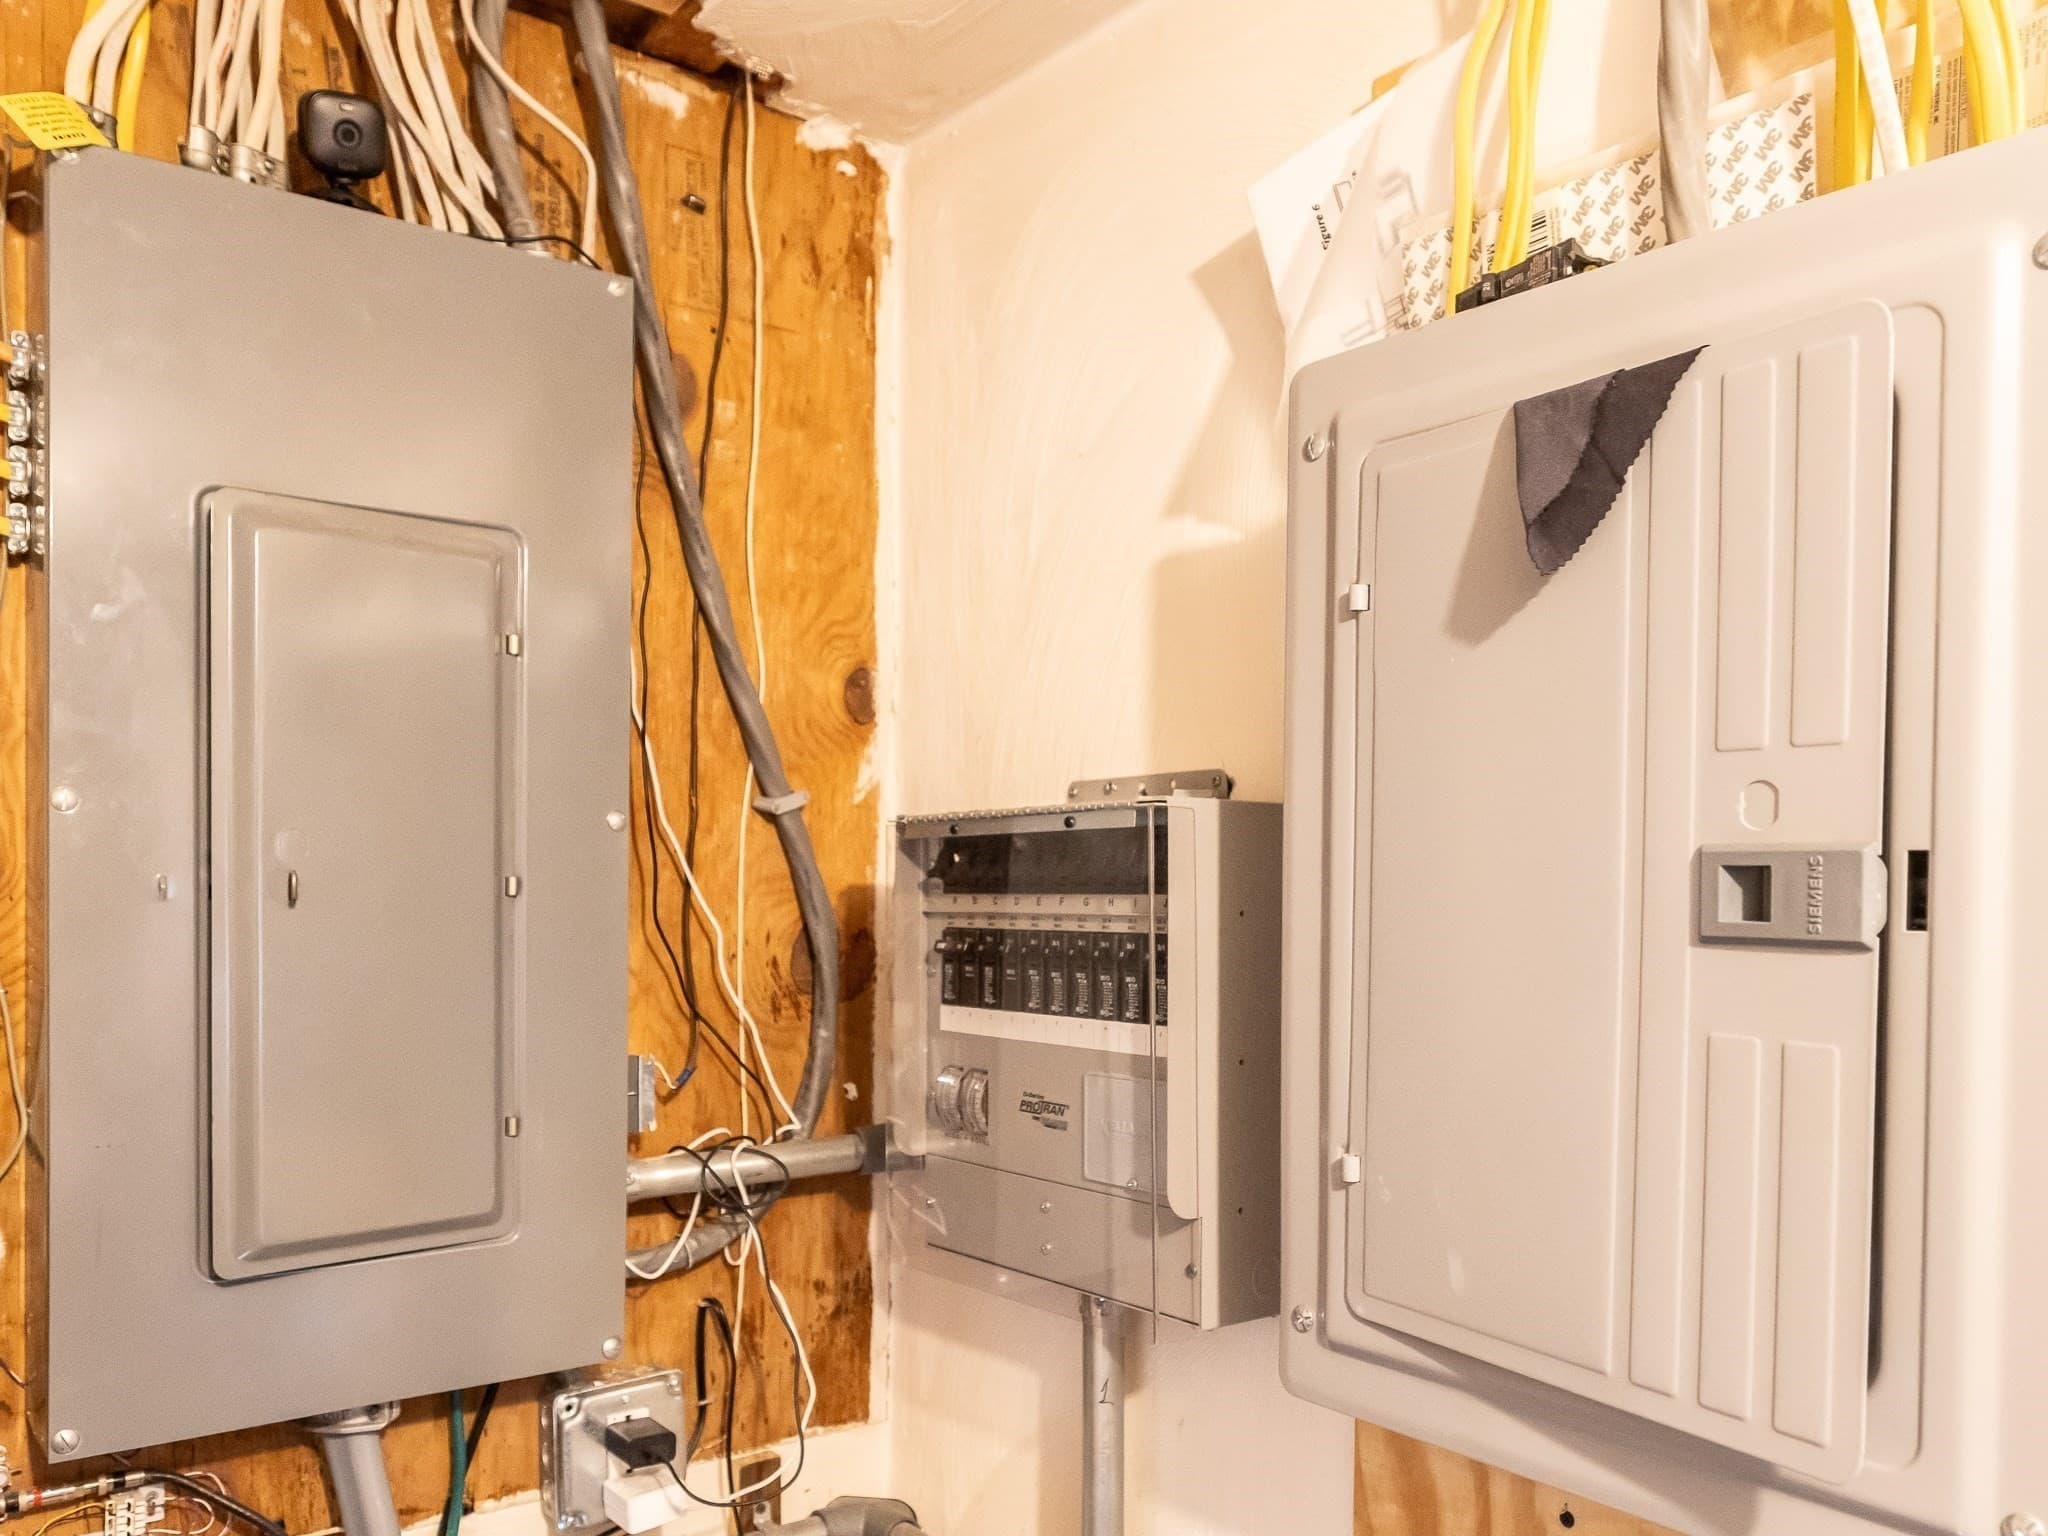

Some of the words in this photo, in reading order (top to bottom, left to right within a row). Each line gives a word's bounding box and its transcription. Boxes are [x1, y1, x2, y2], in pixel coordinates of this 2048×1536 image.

[1754, 128, 1783, 161] 3M
[1788, 115, 1813, 149] 3M
[1721, 140, 1749, 173] 3M
[1789, 149, 1814, 182] 3M
[1630, 174, 1656, 206] 3M
[1722, 172, 1749, 205] 3M
[1755, 161, 1783, 194] 3M
[1572, 195, 1596, 225] 3M
[1600, 185, 1625, 215] 3M
[1601, 215, 1625, 245] 3M
[1630, 205, 1656, 236] 3M
[1424, 278, 1443, 305] 3M
[1059, 896, 1065, 906] F
[1083, 897, 1090, 907] G
[1108, 897, 1114, 907] H
[1808, 855, 1824, 935] SIEMENS
